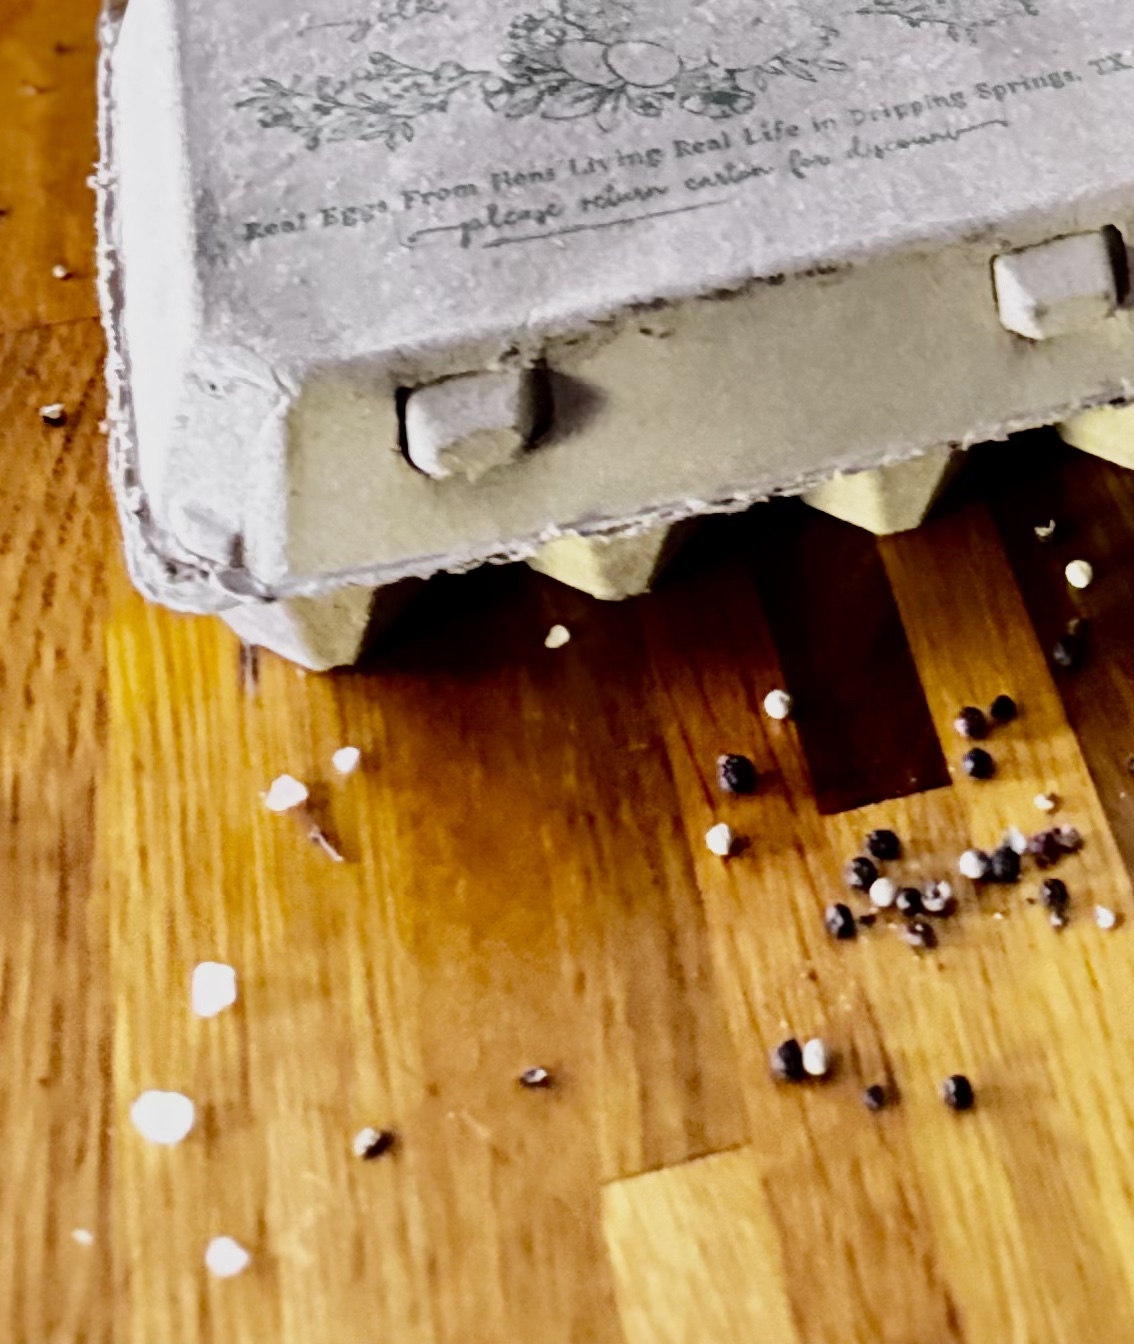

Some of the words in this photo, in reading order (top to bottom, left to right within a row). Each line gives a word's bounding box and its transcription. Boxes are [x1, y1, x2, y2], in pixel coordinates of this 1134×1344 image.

[243, 211, 306, 242] Real
[320, 198, 389, 229] Eggs
[401, 183, 479, 210] From
[490, 165, 556, 190] Hens
[569, 145, 664, 178] Living
[673, 130, 732, 157] Real
[744, 119, 800, 146] Life
[1087, 52, 1134, 77] TX
[788, 147, 832, 180] for
